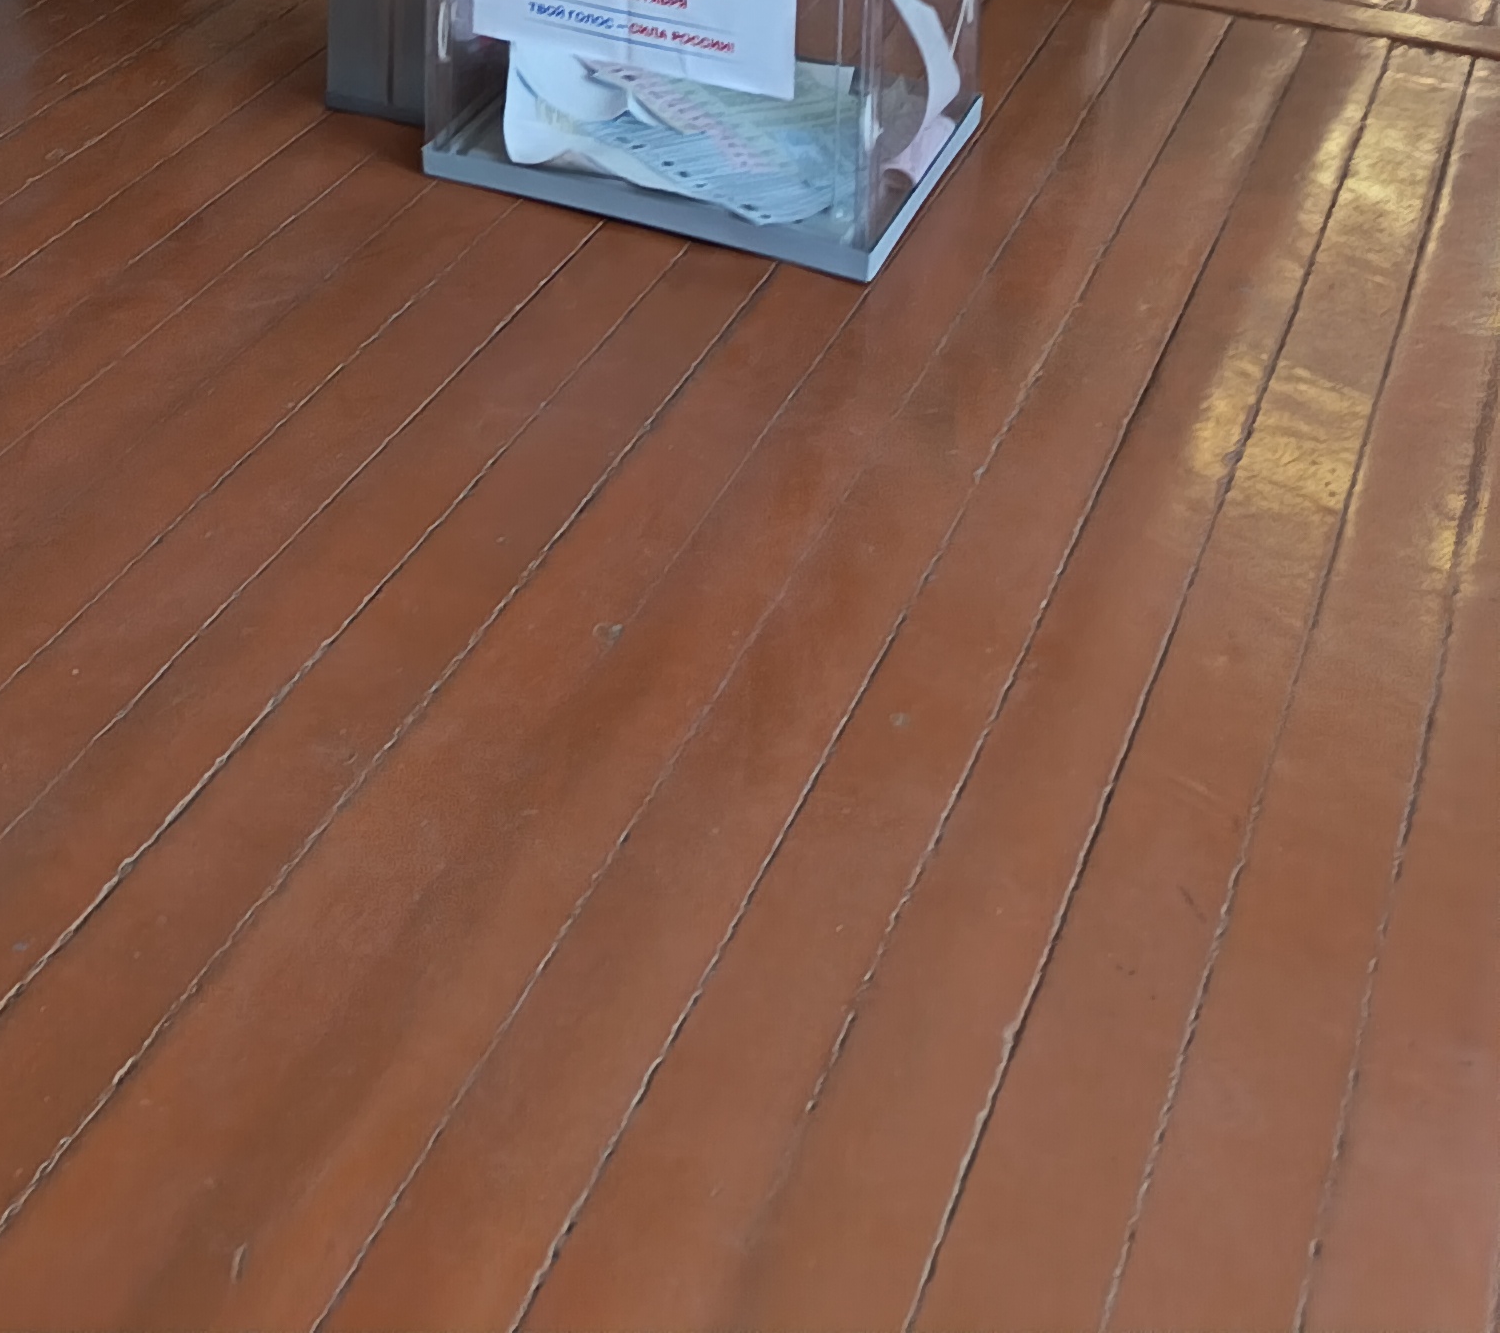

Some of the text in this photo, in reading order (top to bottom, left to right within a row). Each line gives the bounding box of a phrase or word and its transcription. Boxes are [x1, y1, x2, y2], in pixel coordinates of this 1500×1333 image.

[528, 1, 565, 19] ТВОЙ
[567, 9, 614, 29] ГОЛОС
[629, 22, 668, 40] СИЛА
